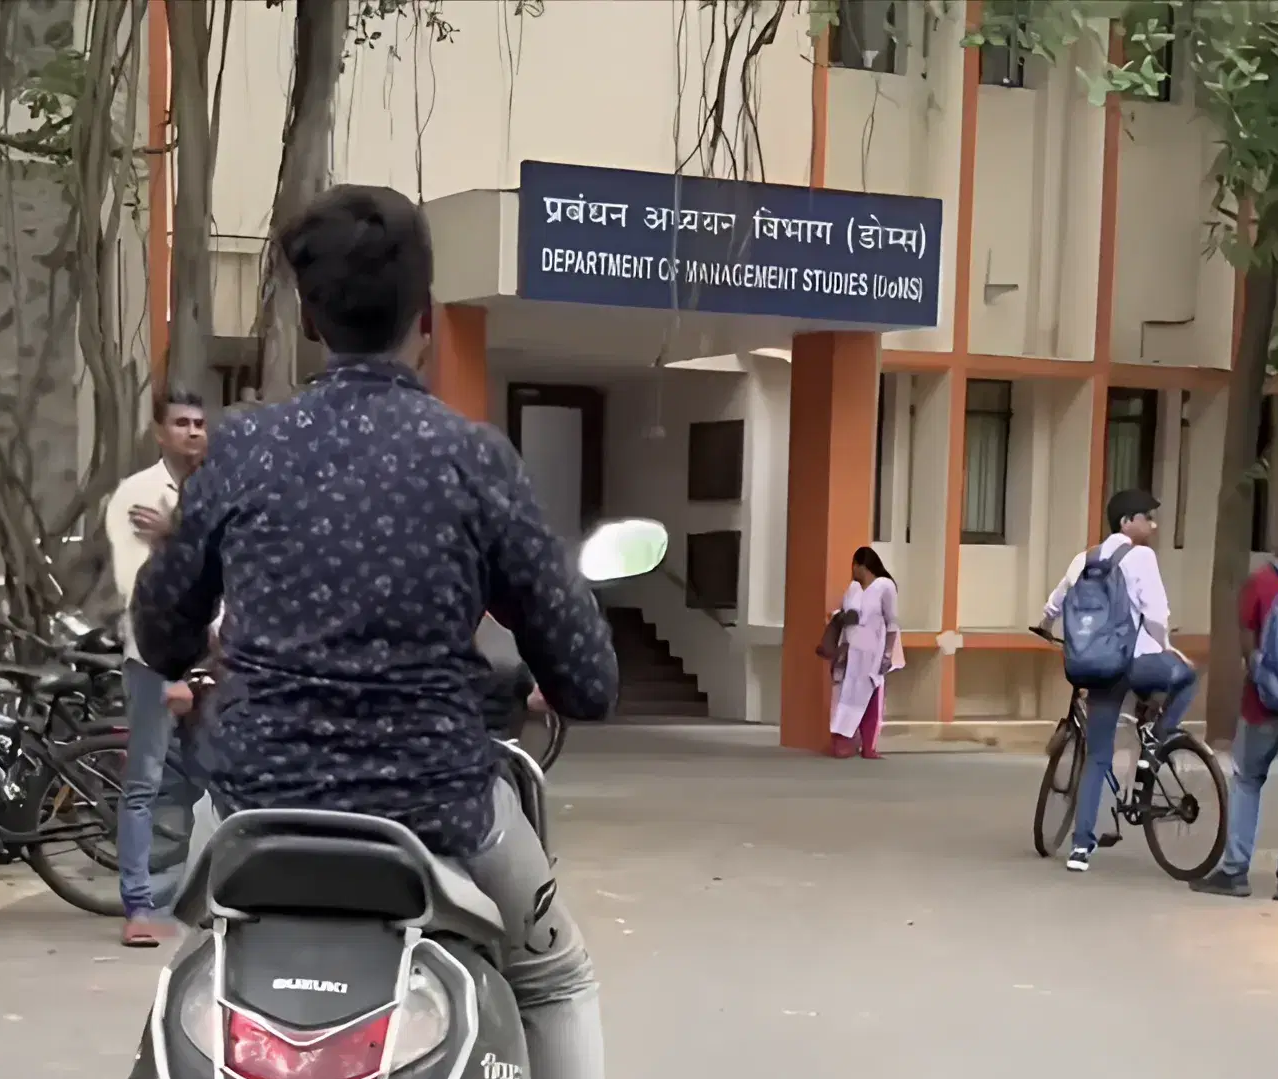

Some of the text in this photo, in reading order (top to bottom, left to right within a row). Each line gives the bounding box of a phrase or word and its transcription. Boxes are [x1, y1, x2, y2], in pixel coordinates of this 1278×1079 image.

[543, 193, 629, 228] प्रबंधन
[753, 206, 834, 245] विभाग
[542, 247, 654, 280] DEPARTMENT
[658, 257, 681, 282] OF
[685, 260, 799, 291] MANAGEMENT
[802, 268, 869, 297] STUDIES
